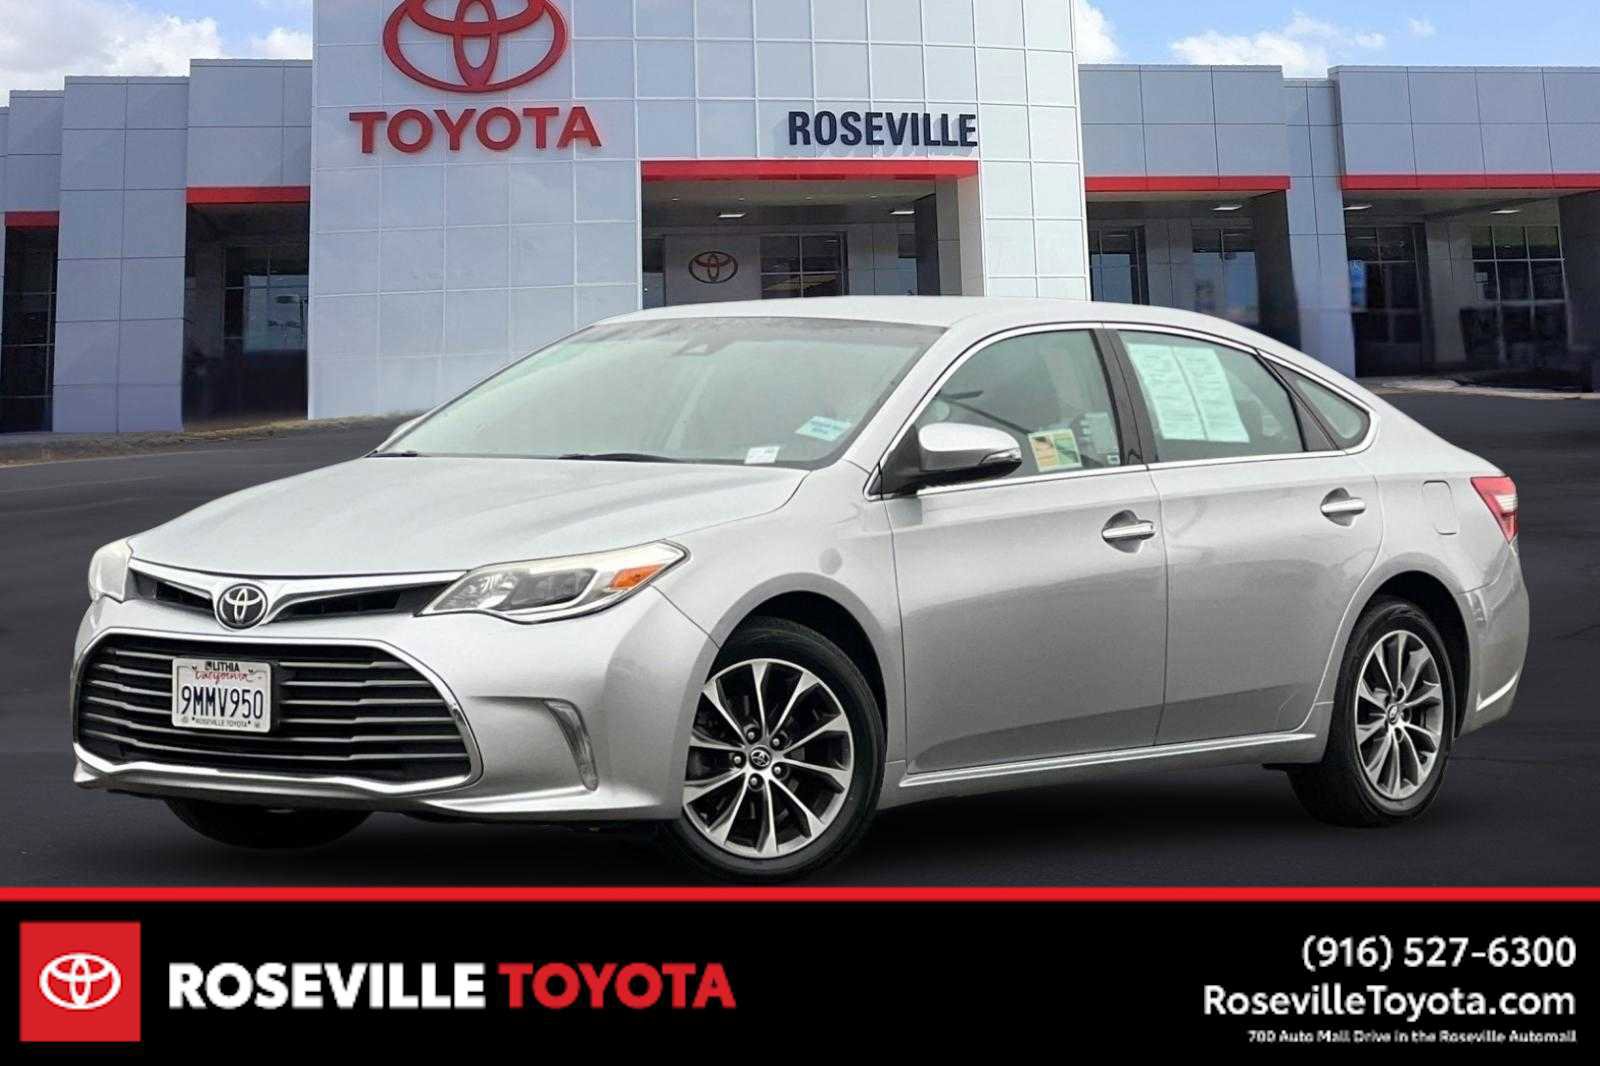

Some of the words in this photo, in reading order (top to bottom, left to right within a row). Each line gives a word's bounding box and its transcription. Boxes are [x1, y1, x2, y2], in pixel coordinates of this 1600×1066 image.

[350, 106, 602, 154] TOYOTA
[788, 111, 978, 147] ROSEVILLE
[213, 661, 240, 672] LITHIA
[181, 685, 264, 720] 9MMV950
